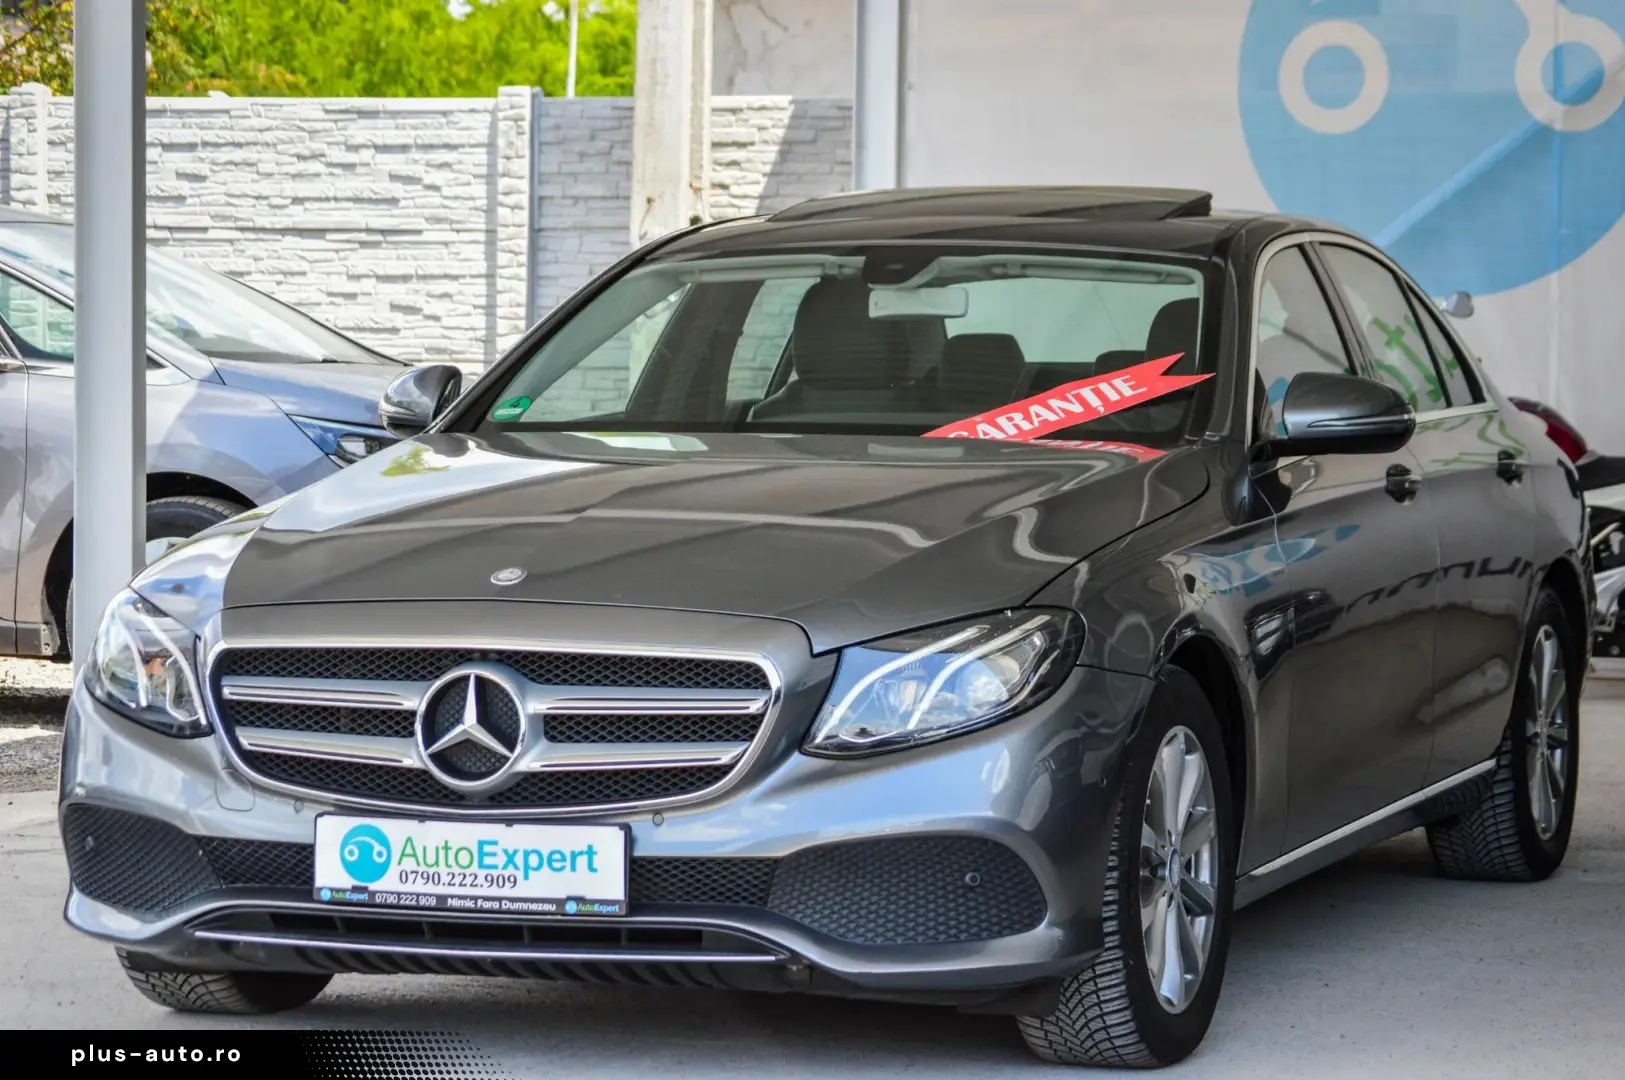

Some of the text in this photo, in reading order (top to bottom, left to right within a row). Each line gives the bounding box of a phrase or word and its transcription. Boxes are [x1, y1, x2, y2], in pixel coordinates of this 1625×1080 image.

[397, 836, 598, 880] AutoExpert
[400, 869, 518, 889] 0790.222.909
[331, 890, 369, 901] AutoExpert
[375, 892, 437, 906] 0790 222 909
[447, 898, 557, 912] Nimic Fara Dumnezeu
[577, 903, 620, 914] AutoExpert
